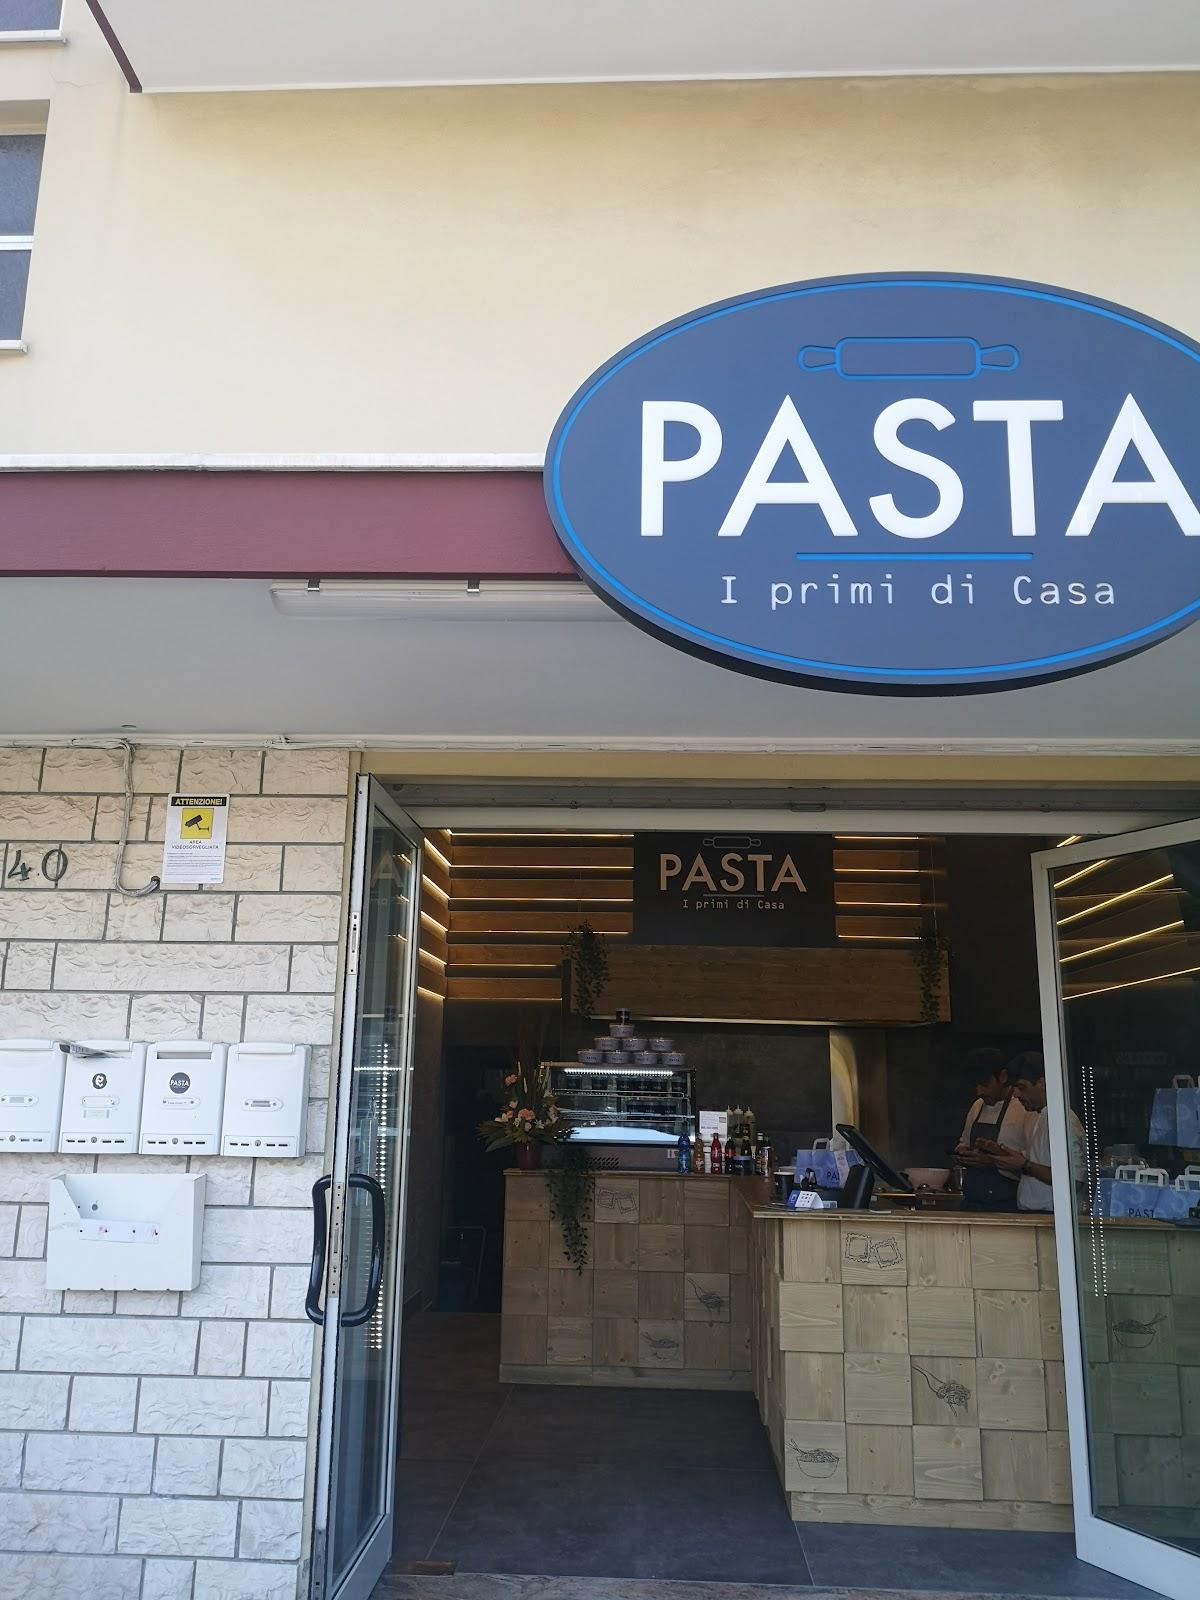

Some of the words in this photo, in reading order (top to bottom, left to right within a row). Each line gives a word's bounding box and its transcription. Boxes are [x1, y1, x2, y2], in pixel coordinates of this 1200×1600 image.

[641, 393, 1200, 539] PASTA
[720, 575, 738, 605] I
[771, 574, 895, 610] primi
[931, 573, 976, 605] di
[1013, 575, 1116, 605] Casa
[175, 798, 223, 806] ATTENZIONE!
[659, 852, 808, 893] PASTA
[682, 899, 689, 908] I
[696, 899, 729, 911] primi
[736, 899, 750, 910] di
[757, 900, 785, 910] Casa
[170, 1079, 190, 1087] PASTA
[826, 1171, 840, 1181] PA
